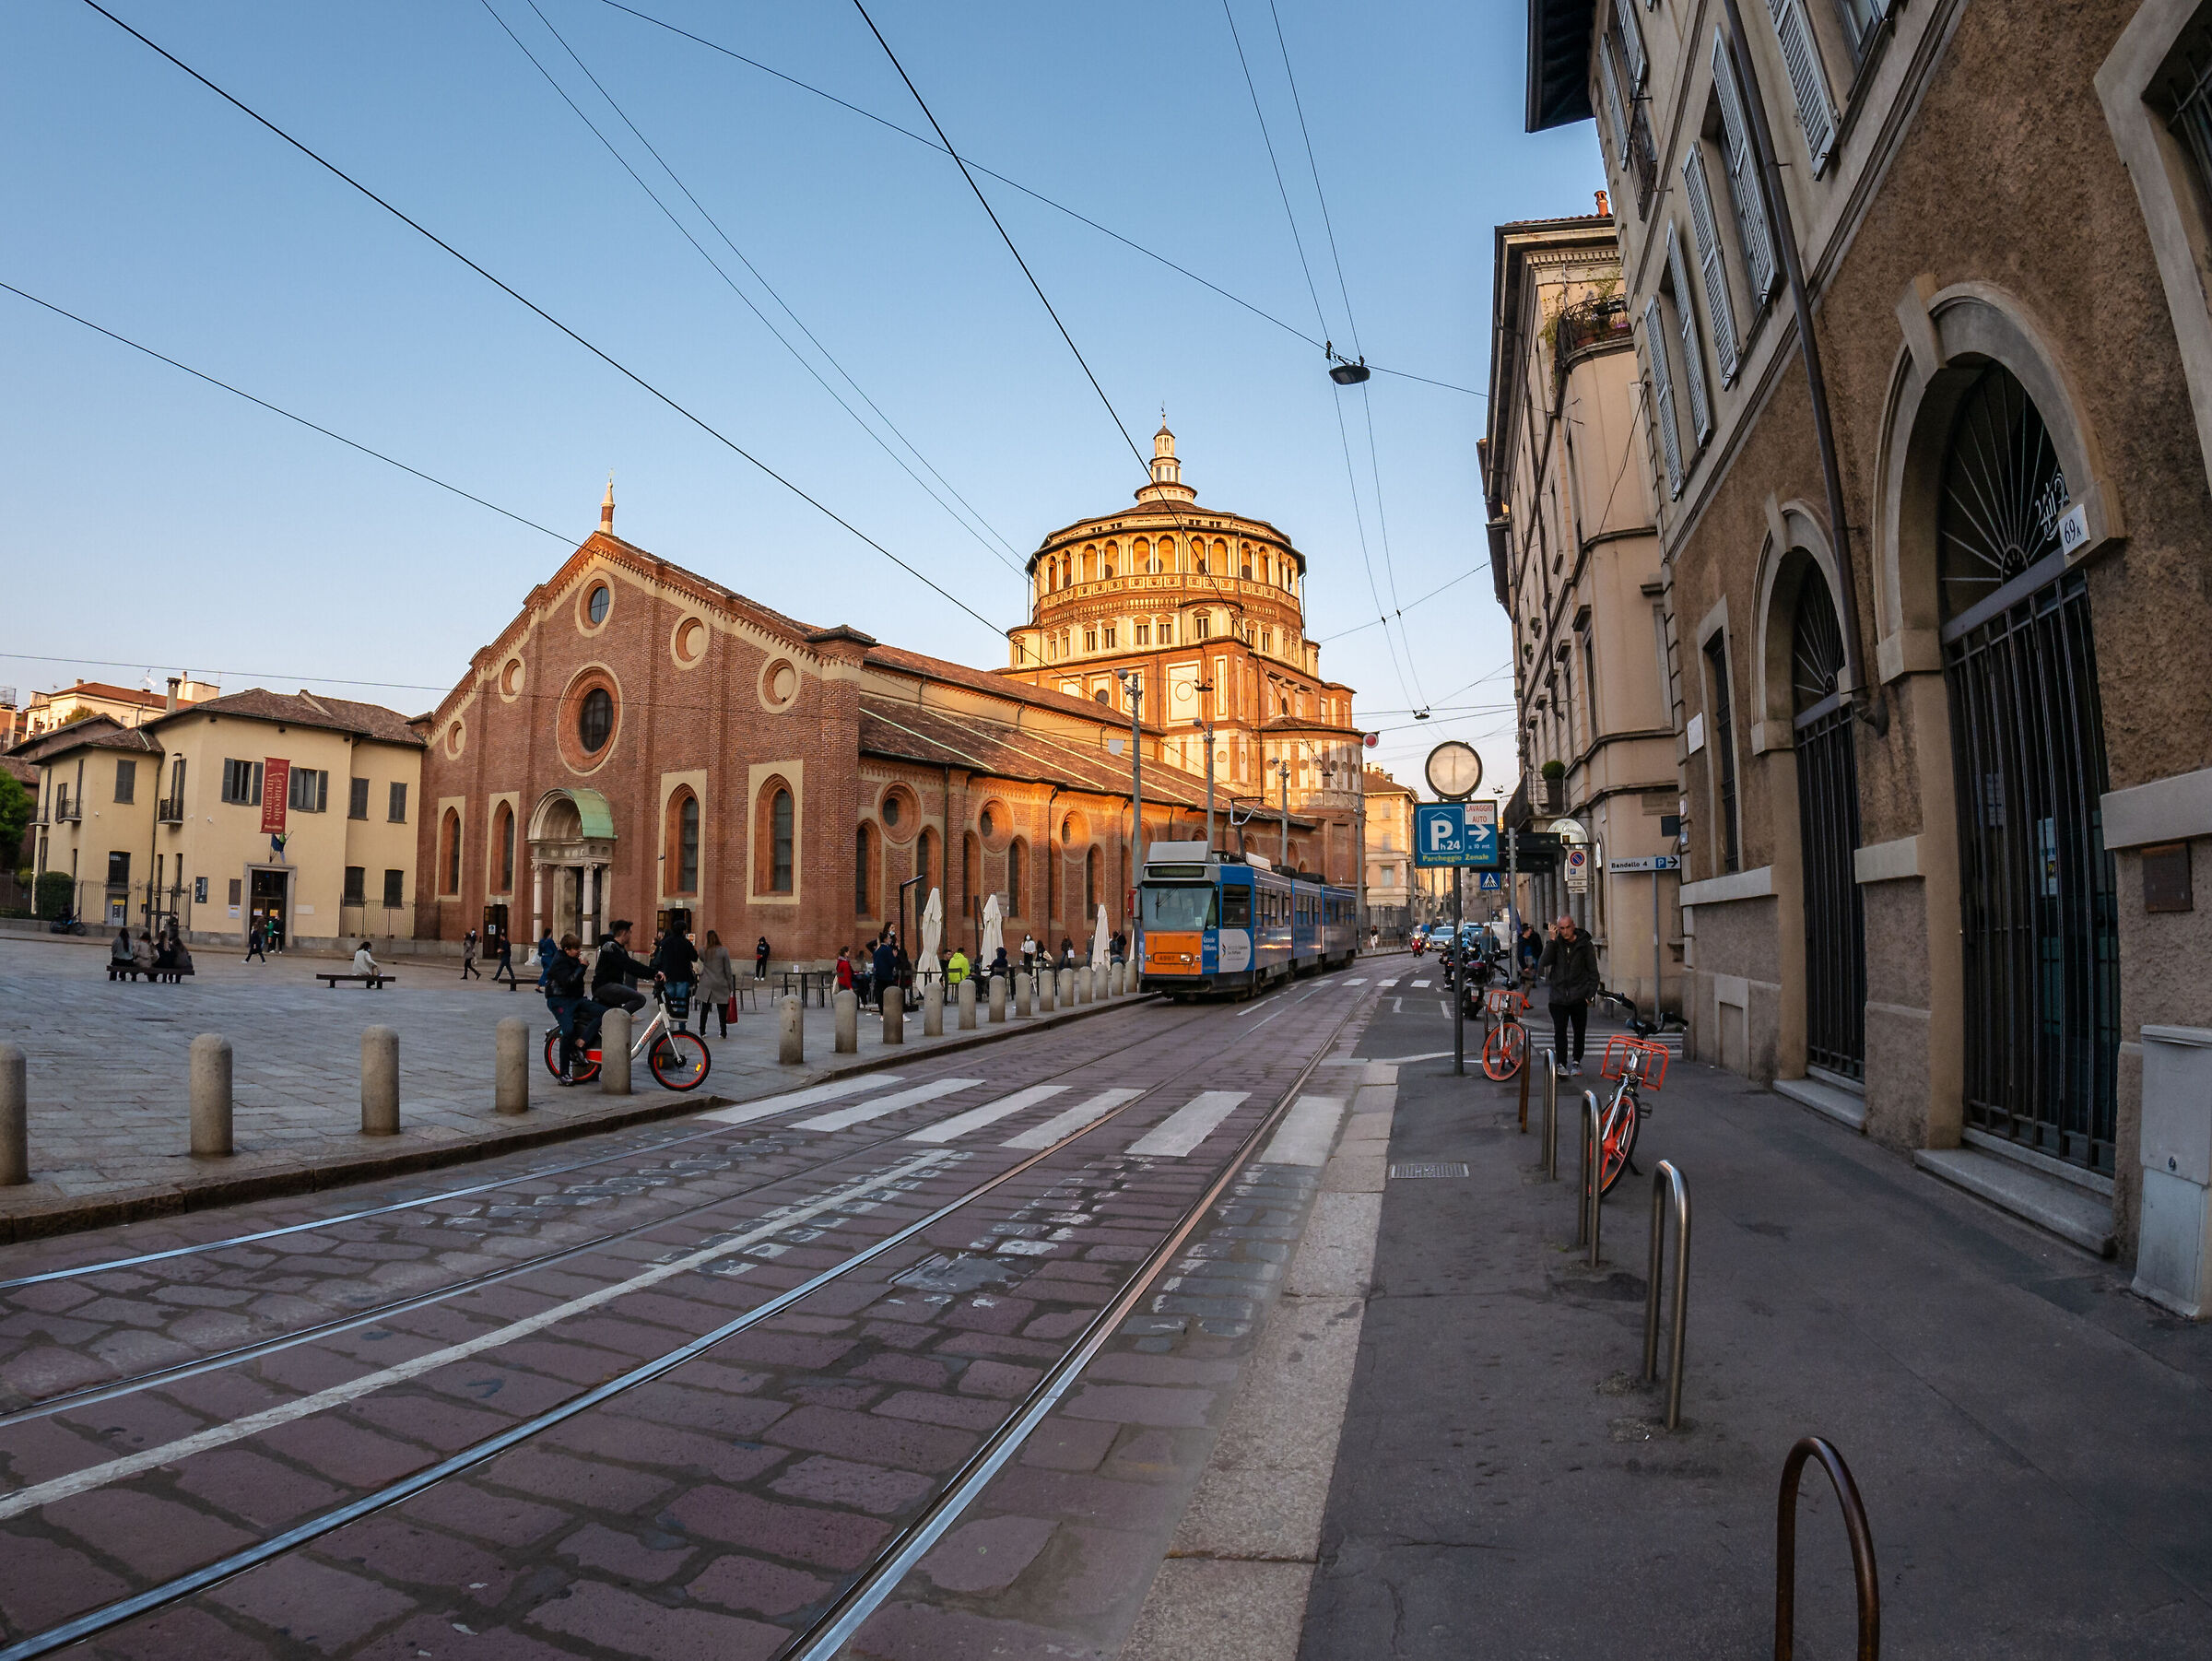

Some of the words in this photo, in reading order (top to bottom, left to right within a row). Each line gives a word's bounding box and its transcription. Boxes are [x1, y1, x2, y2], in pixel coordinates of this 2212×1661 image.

[265, 773, 276, 819] Vinciano
[274, 772, 286, 820] Cenacolo
[1430, 819, 1453, 851] P
[1440, 840, 1461, 851] h24
[1422, 854, 1462, 863] Parcheggio
